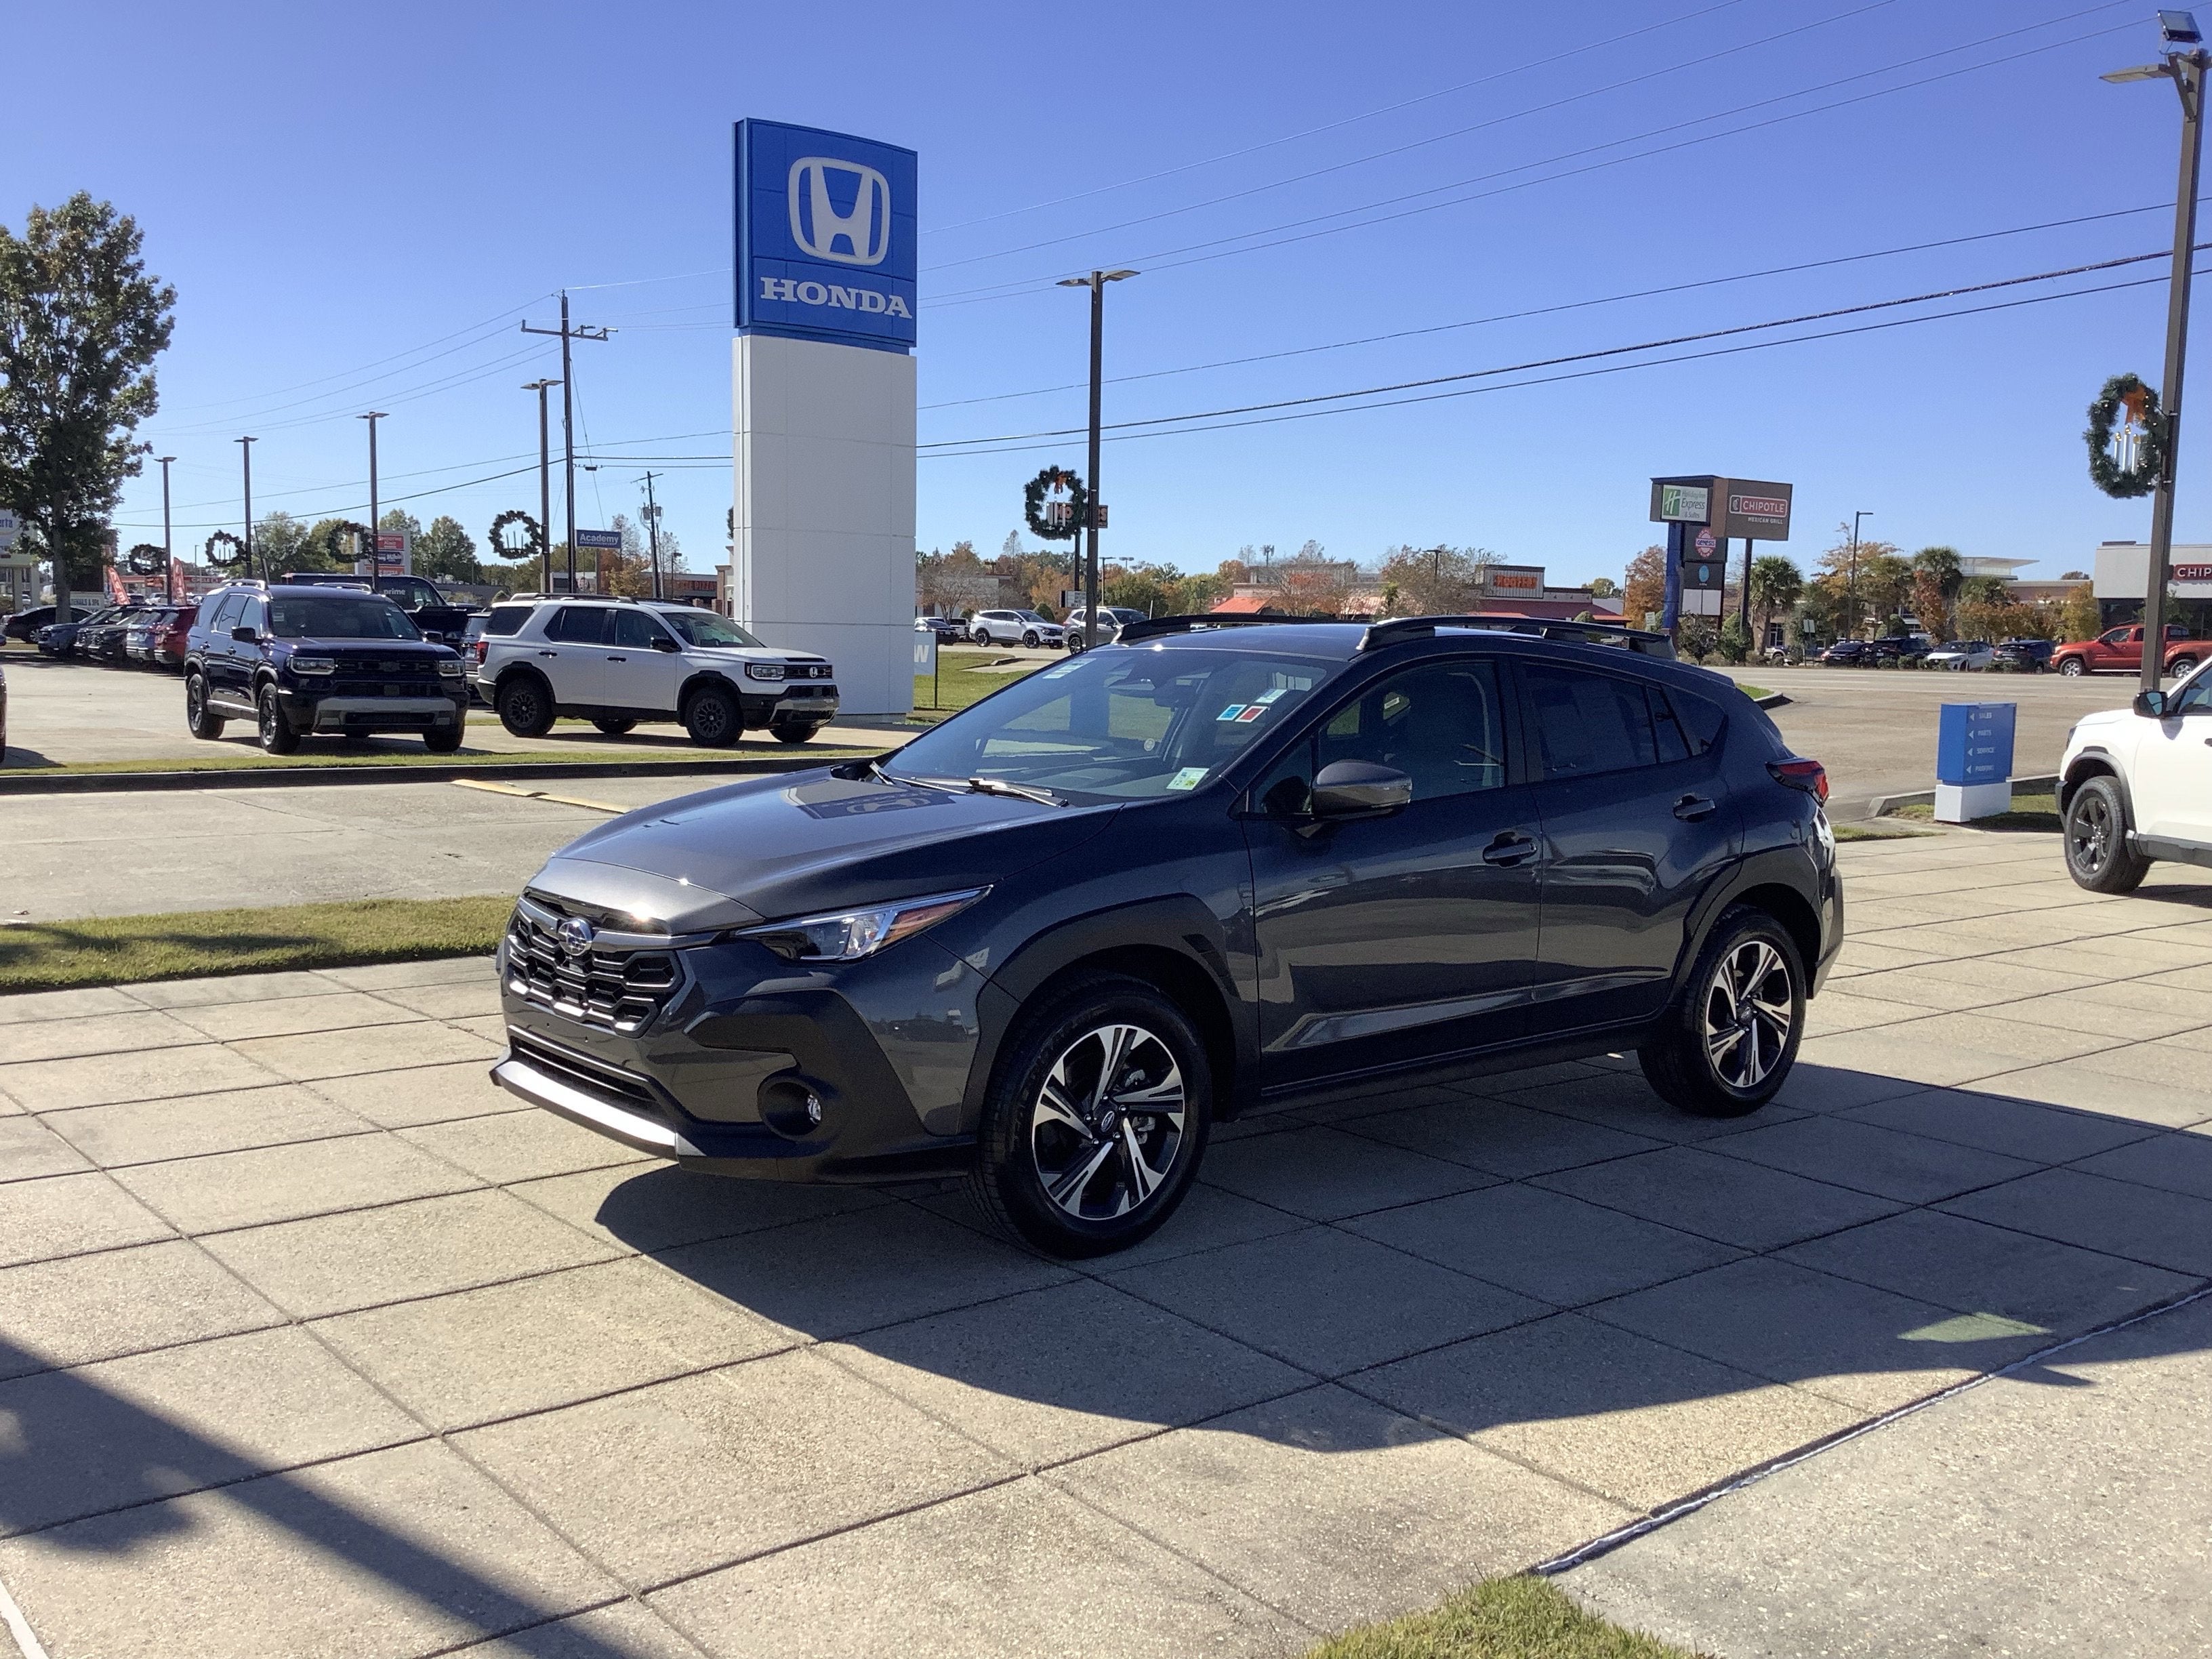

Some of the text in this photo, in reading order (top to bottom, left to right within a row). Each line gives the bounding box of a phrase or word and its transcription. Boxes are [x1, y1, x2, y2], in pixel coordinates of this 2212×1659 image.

[760, 276, 912, 319] HONDA
[1681, 497, 1705, 511] Express
[1742, 500, 1784, 513] CHIPOTLE
[579, 533, 619, 545] Academy
[384, 588, 405, 596] prime
